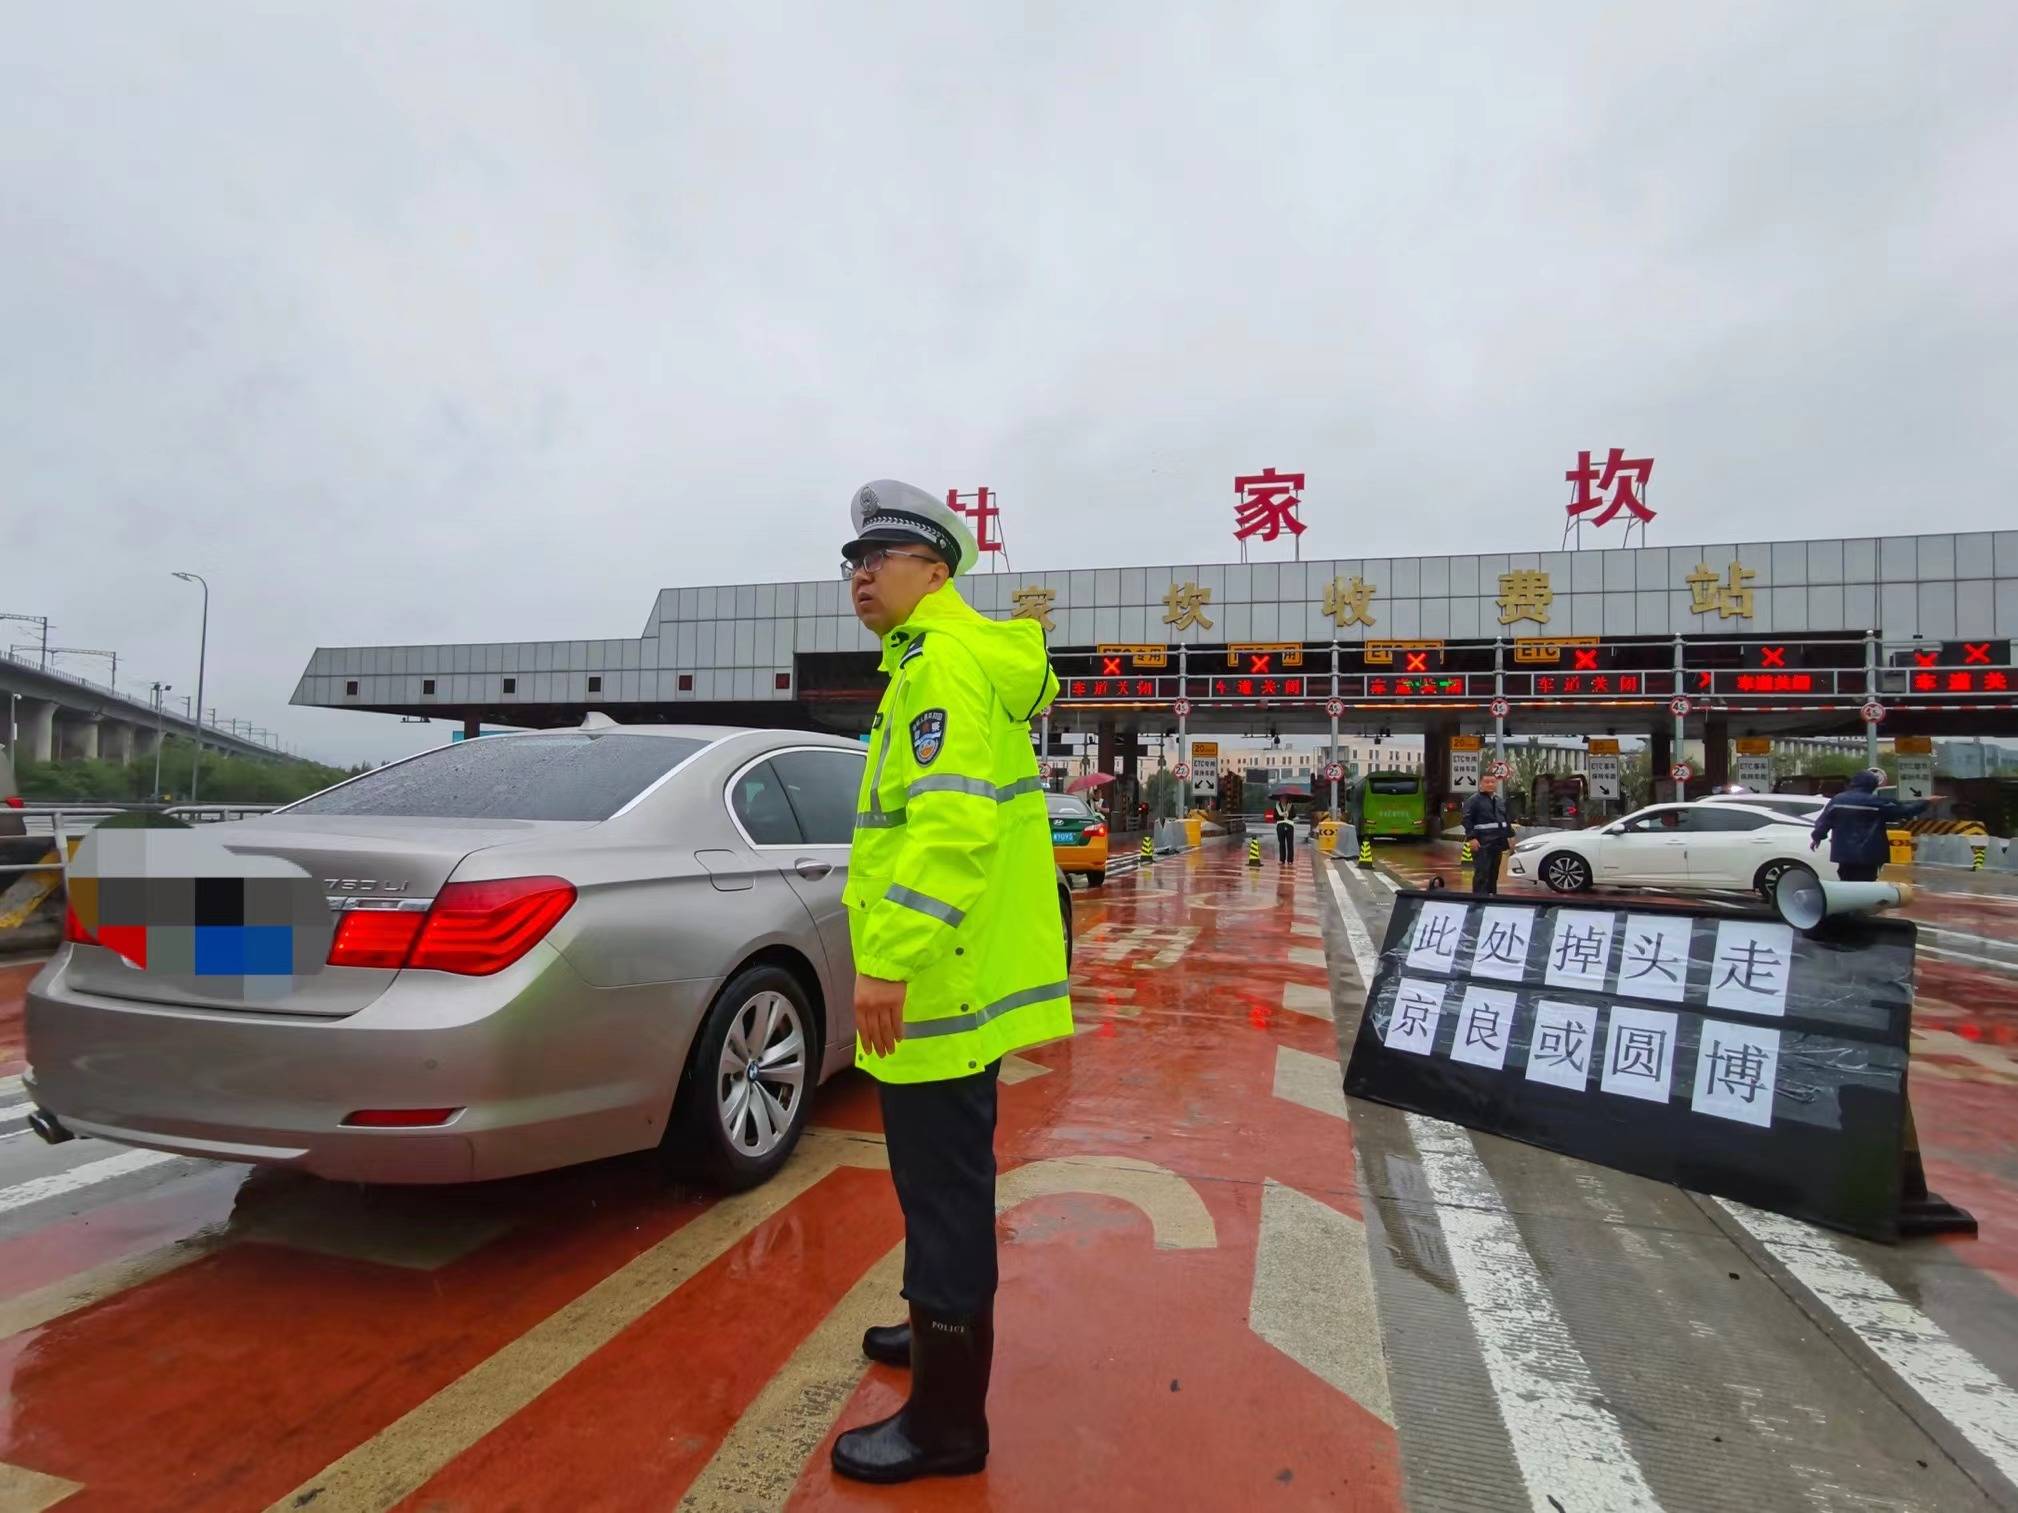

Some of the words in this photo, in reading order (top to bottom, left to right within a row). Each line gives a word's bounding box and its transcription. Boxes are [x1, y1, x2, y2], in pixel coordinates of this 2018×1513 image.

[1414, 915, 1782, 995] 此处掉头走
[1392, 993, 1769, 1104] 京良或圆博
[931, 1320, 966, 1334] POLICE
